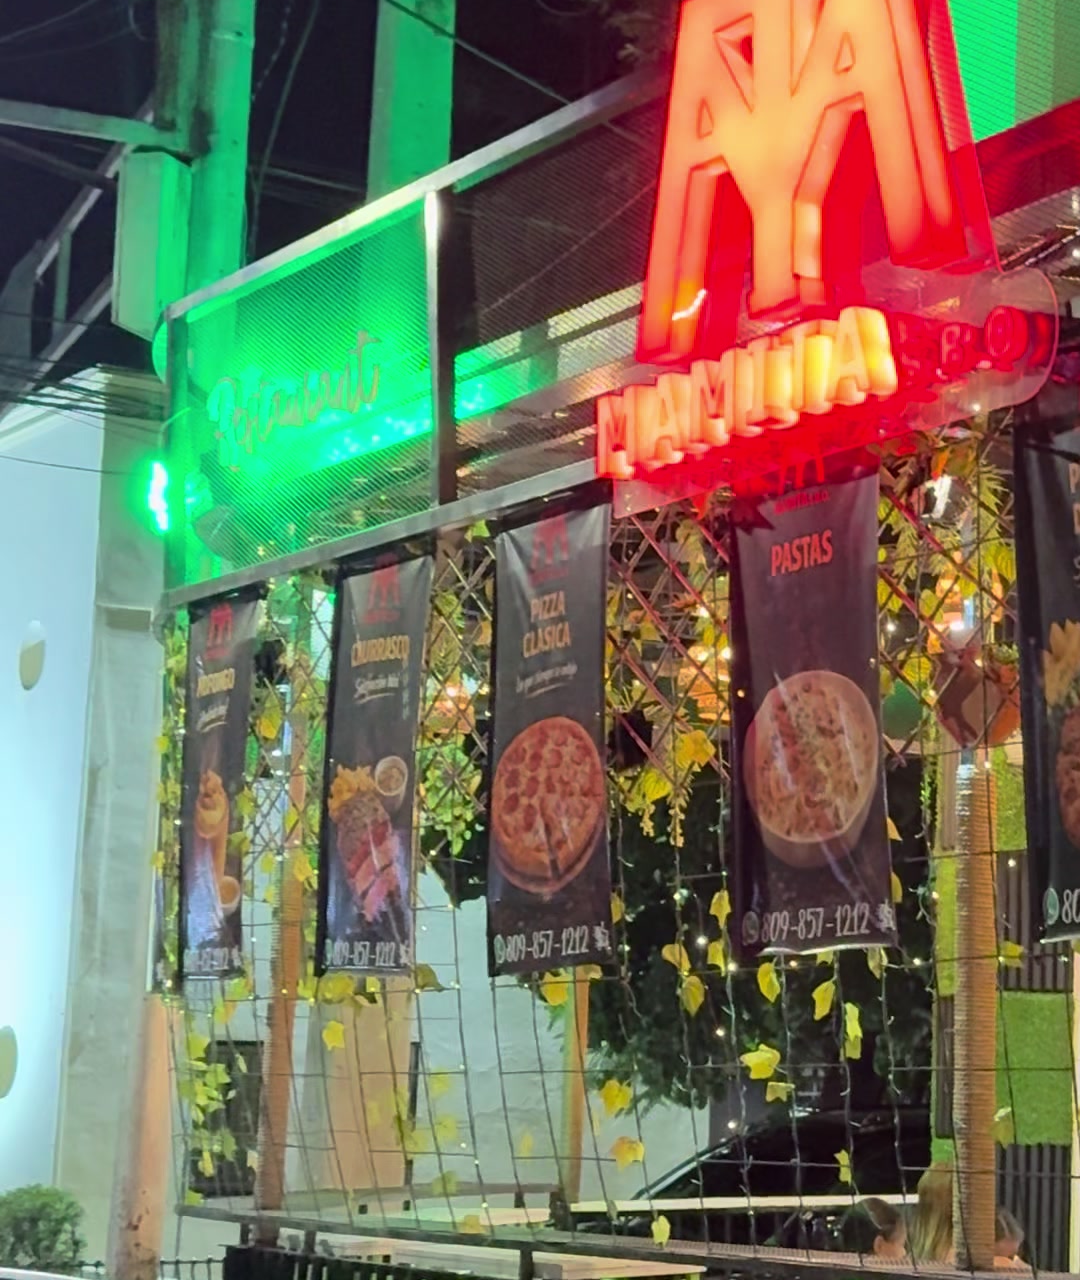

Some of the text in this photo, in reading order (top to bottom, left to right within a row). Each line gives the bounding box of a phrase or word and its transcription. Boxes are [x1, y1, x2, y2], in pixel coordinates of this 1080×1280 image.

[595, 306, 898, 478] MAMITA
[771, 529, 833, 577] PASTAS
[530, 590, 566, 623] PIZZA
[352, 635, 410, 668] CHURRASCO
[522, 621, 571, 659] CLASICA
[761, 901, 871, 942] 809-857-1212
[505, 924, 590, 963] 809-857-1212
